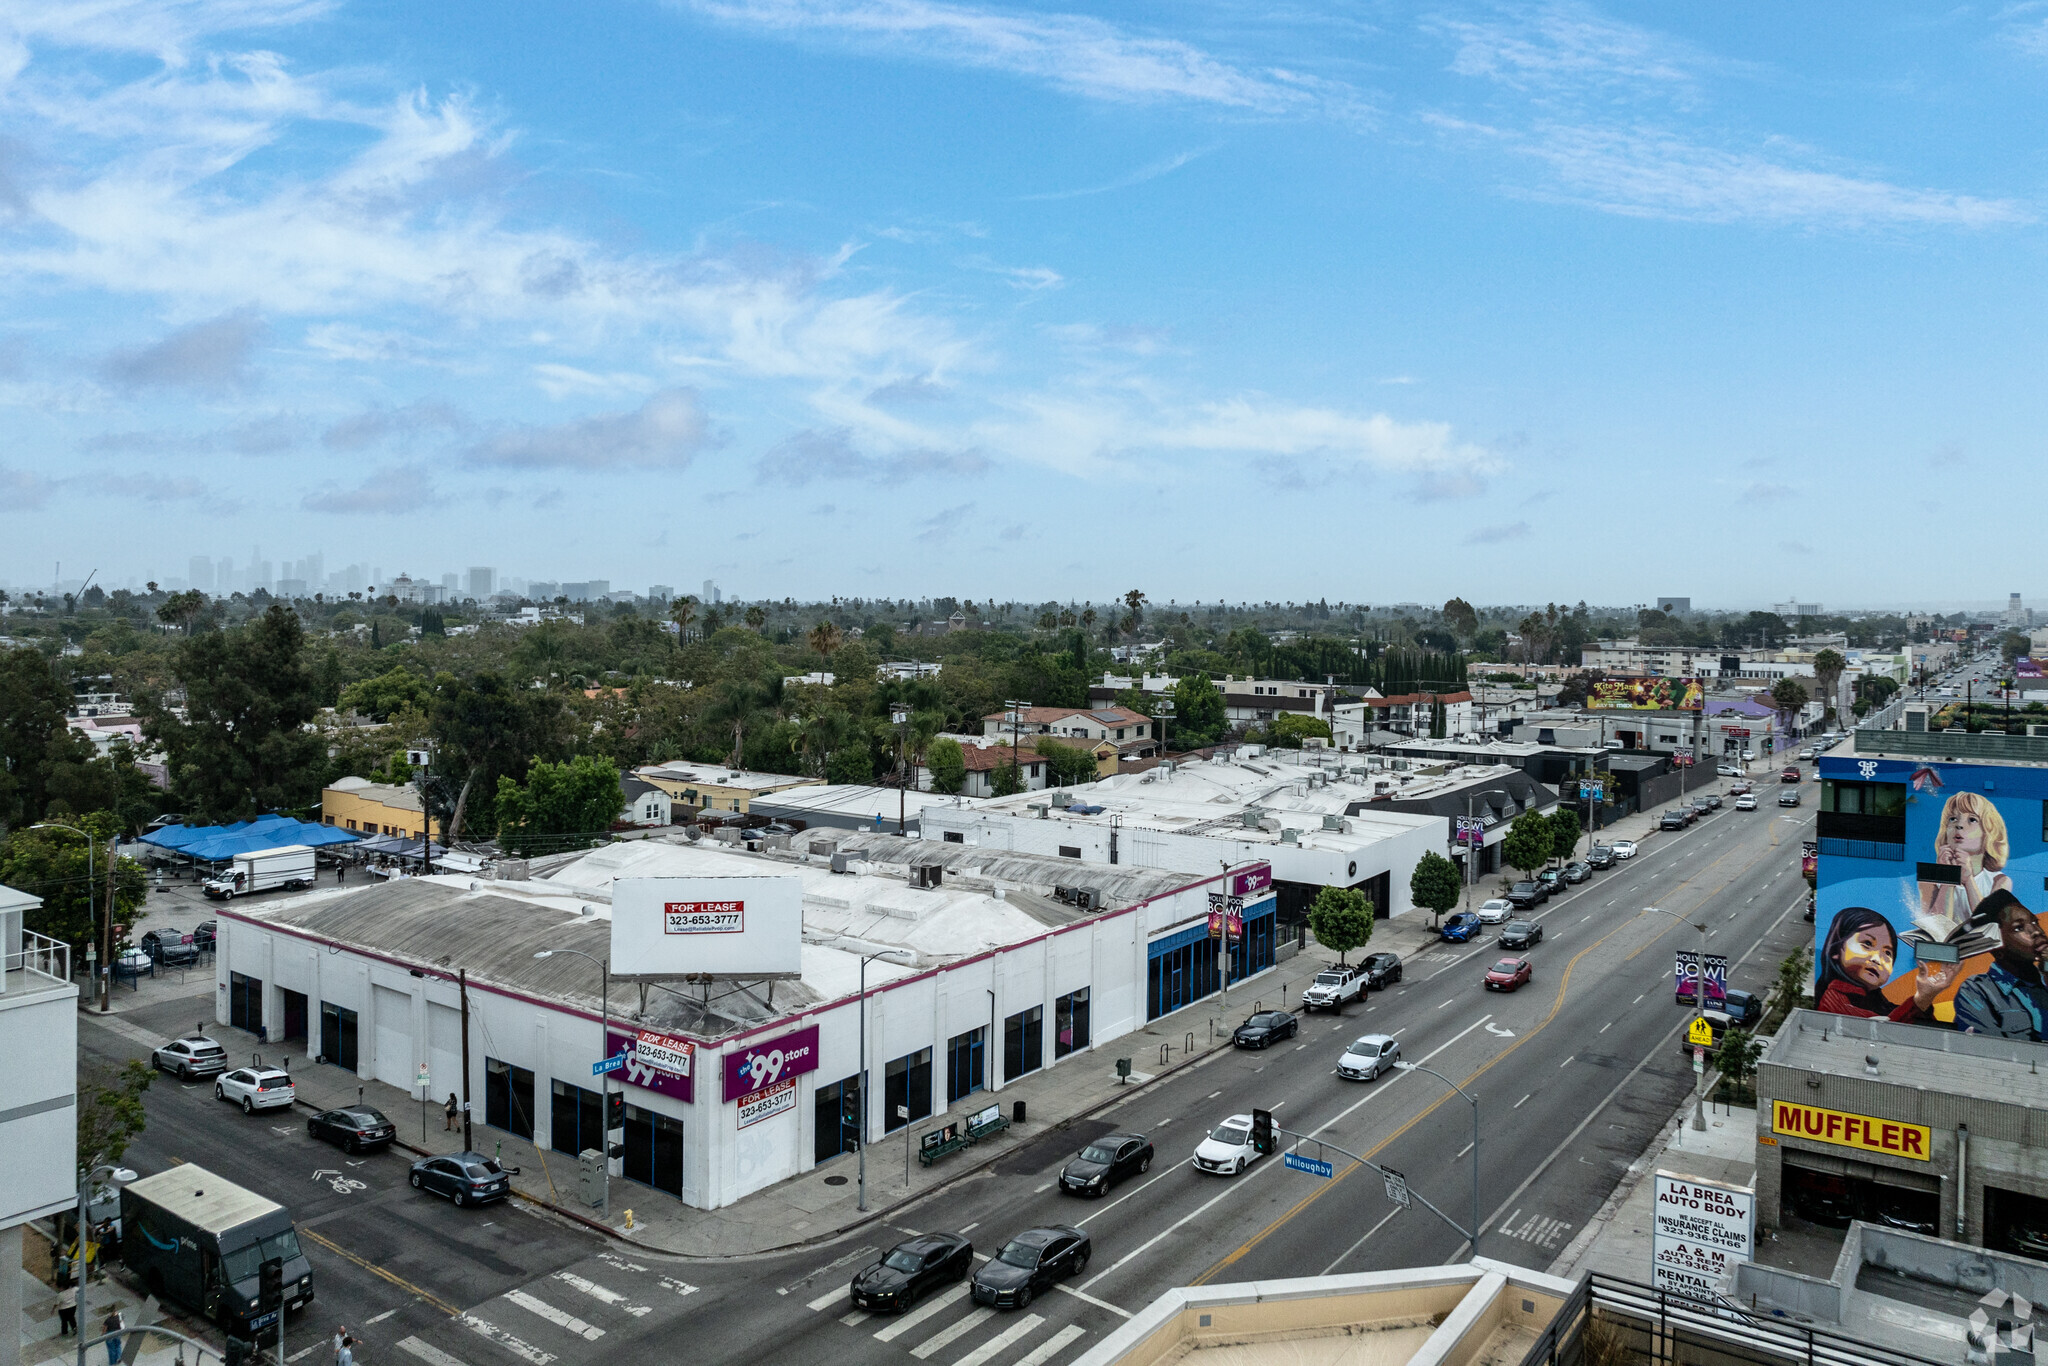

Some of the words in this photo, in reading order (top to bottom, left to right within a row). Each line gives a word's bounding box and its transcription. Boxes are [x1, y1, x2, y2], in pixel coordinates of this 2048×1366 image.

[672, 904, 694, 912] FOR
[700, 903, 736, 911] LEASE
[1208, 901, 1243, 918] BOWL
[670, 915, 739, 925] 323-653-3777
[1676, 961, 1727, 981] BOWL
[643, 1033, 660, 1044] FOR
[662, 1038, 689, 1053] LEASE
[605, 1060, 620, 1068] Brea
[638, 1044, 687, 1067] 323-653-3777
[740, 1064, 751, 1075] the
[750, 1049, 784, 1090] 99
[785, 1046, 809, 1062] store
[742, 1093, 760, 1106] FOR
[764, 1081, 791, 1097] LEASE
[741, 1090, 792, 1119] 323-653-3777
[1779, 1106, 1922, 1155] MUFFLER
[1285, 1156, 1331, 1176] Willoughby
[1670, 1183, 1689, 1196] LA
[1693, 1188, 1734, 1206] BREA
[1659, 1193, 1699, 1209] AUTO
[1704, 1202, 1746, 1219] BODY
[1498, 1208, 1572, 1249] LANE
[1658, 1216, 1710, 1234] INSURANCE
[1712, 1229, 1746, 1242] CLAIMS
[1690, 1216, 1712, 1226] ACCEPT
[1663, 1225, 1741, 1248] 323-936-9166
[1663, 1249, 1693, 1260] AUTO
[1677, 1243, 1688, 1253] A
[1694, 1248, 1705, 1257] &
[1711, 1252, 1725, 1262] M
[1657, 1268, 1711, 1289] RENTAL
